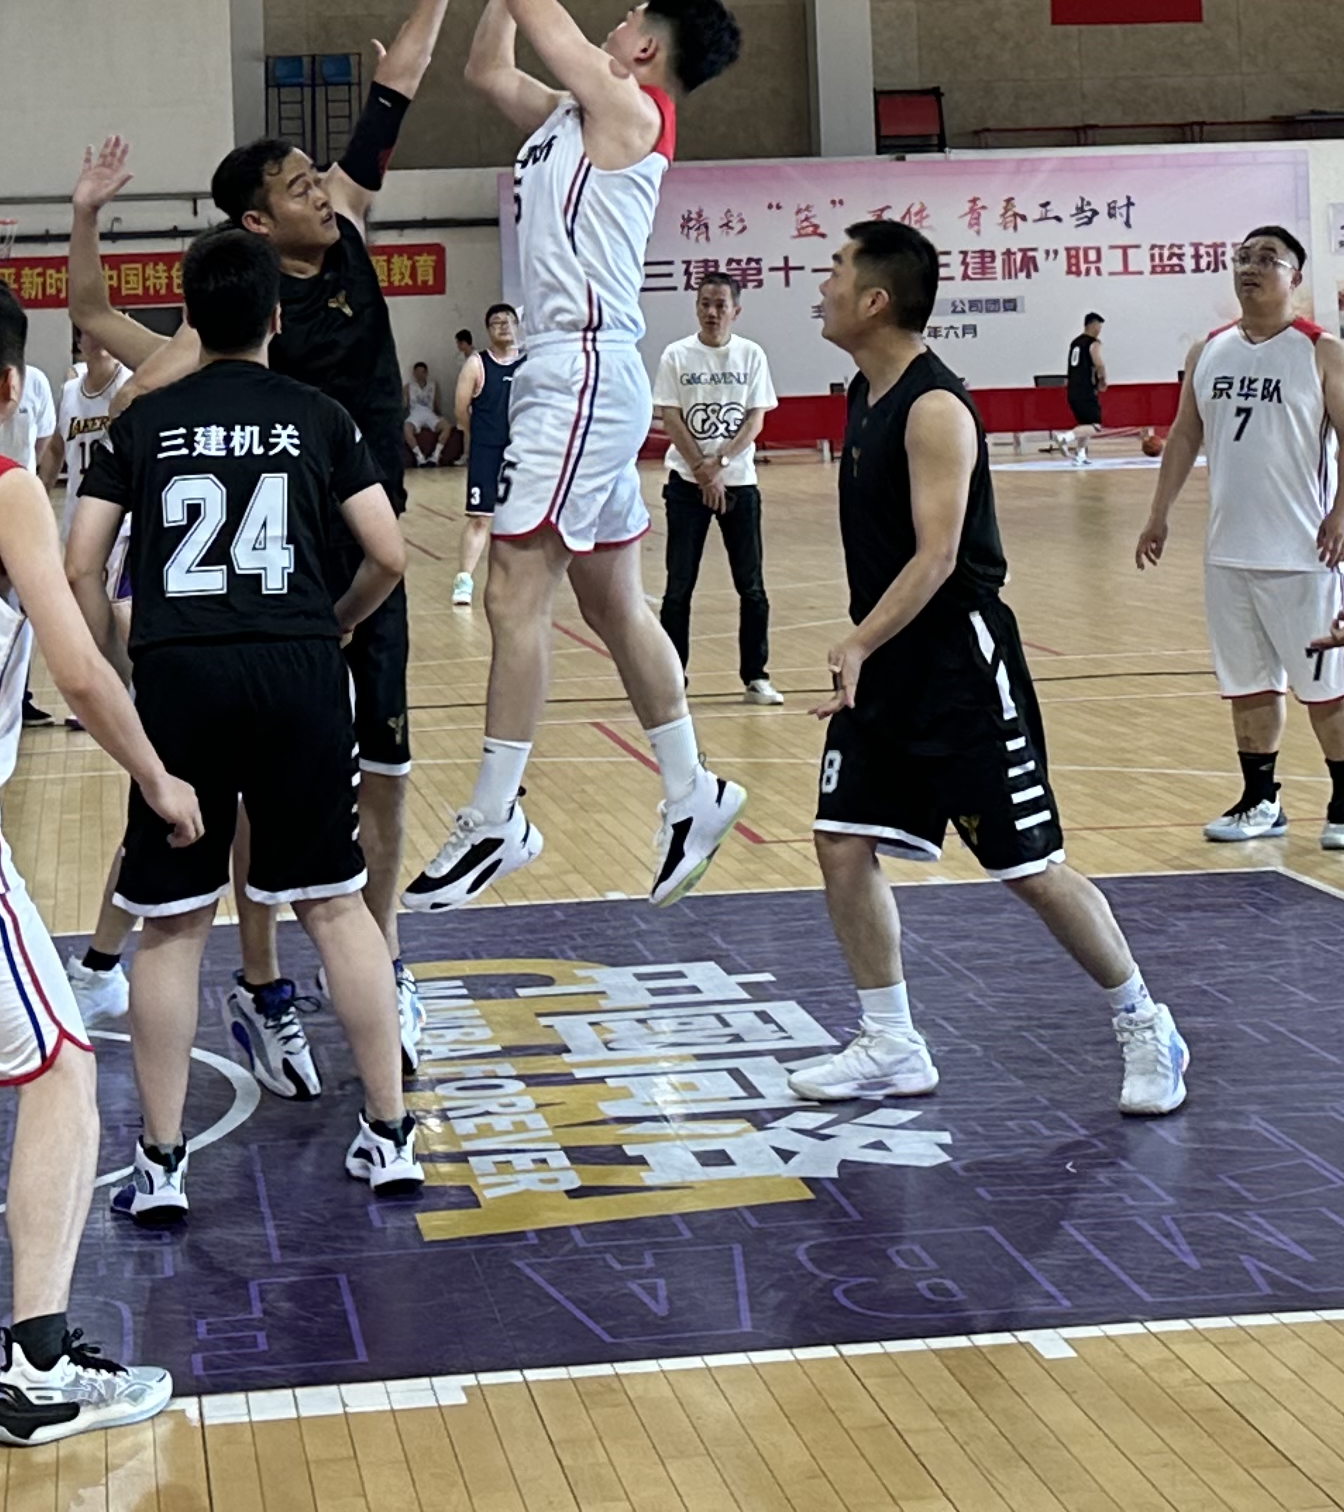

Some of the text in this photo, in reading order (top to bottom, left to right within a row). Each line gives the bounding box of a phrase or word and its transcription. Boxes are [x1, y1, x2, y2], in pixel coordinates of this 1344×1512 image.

[957, 194, 1137, 237] 青春正当时
[1070, 347, 1081, 367] 0
[1212, 375, 1284, 405] 京华队
[66, 415, 111, 442] LAKER
[156, 423, 301, 459] 三建机关
[1233, 406, 1254, 443] 7
[470, 486, 481, 505] 3
[162, 472, 295, 598] 24
[1304, 645, 1325, 682] 7
[821, 749, 842, 794] 8
[422, 1060, 582, 1200] FOREVER
